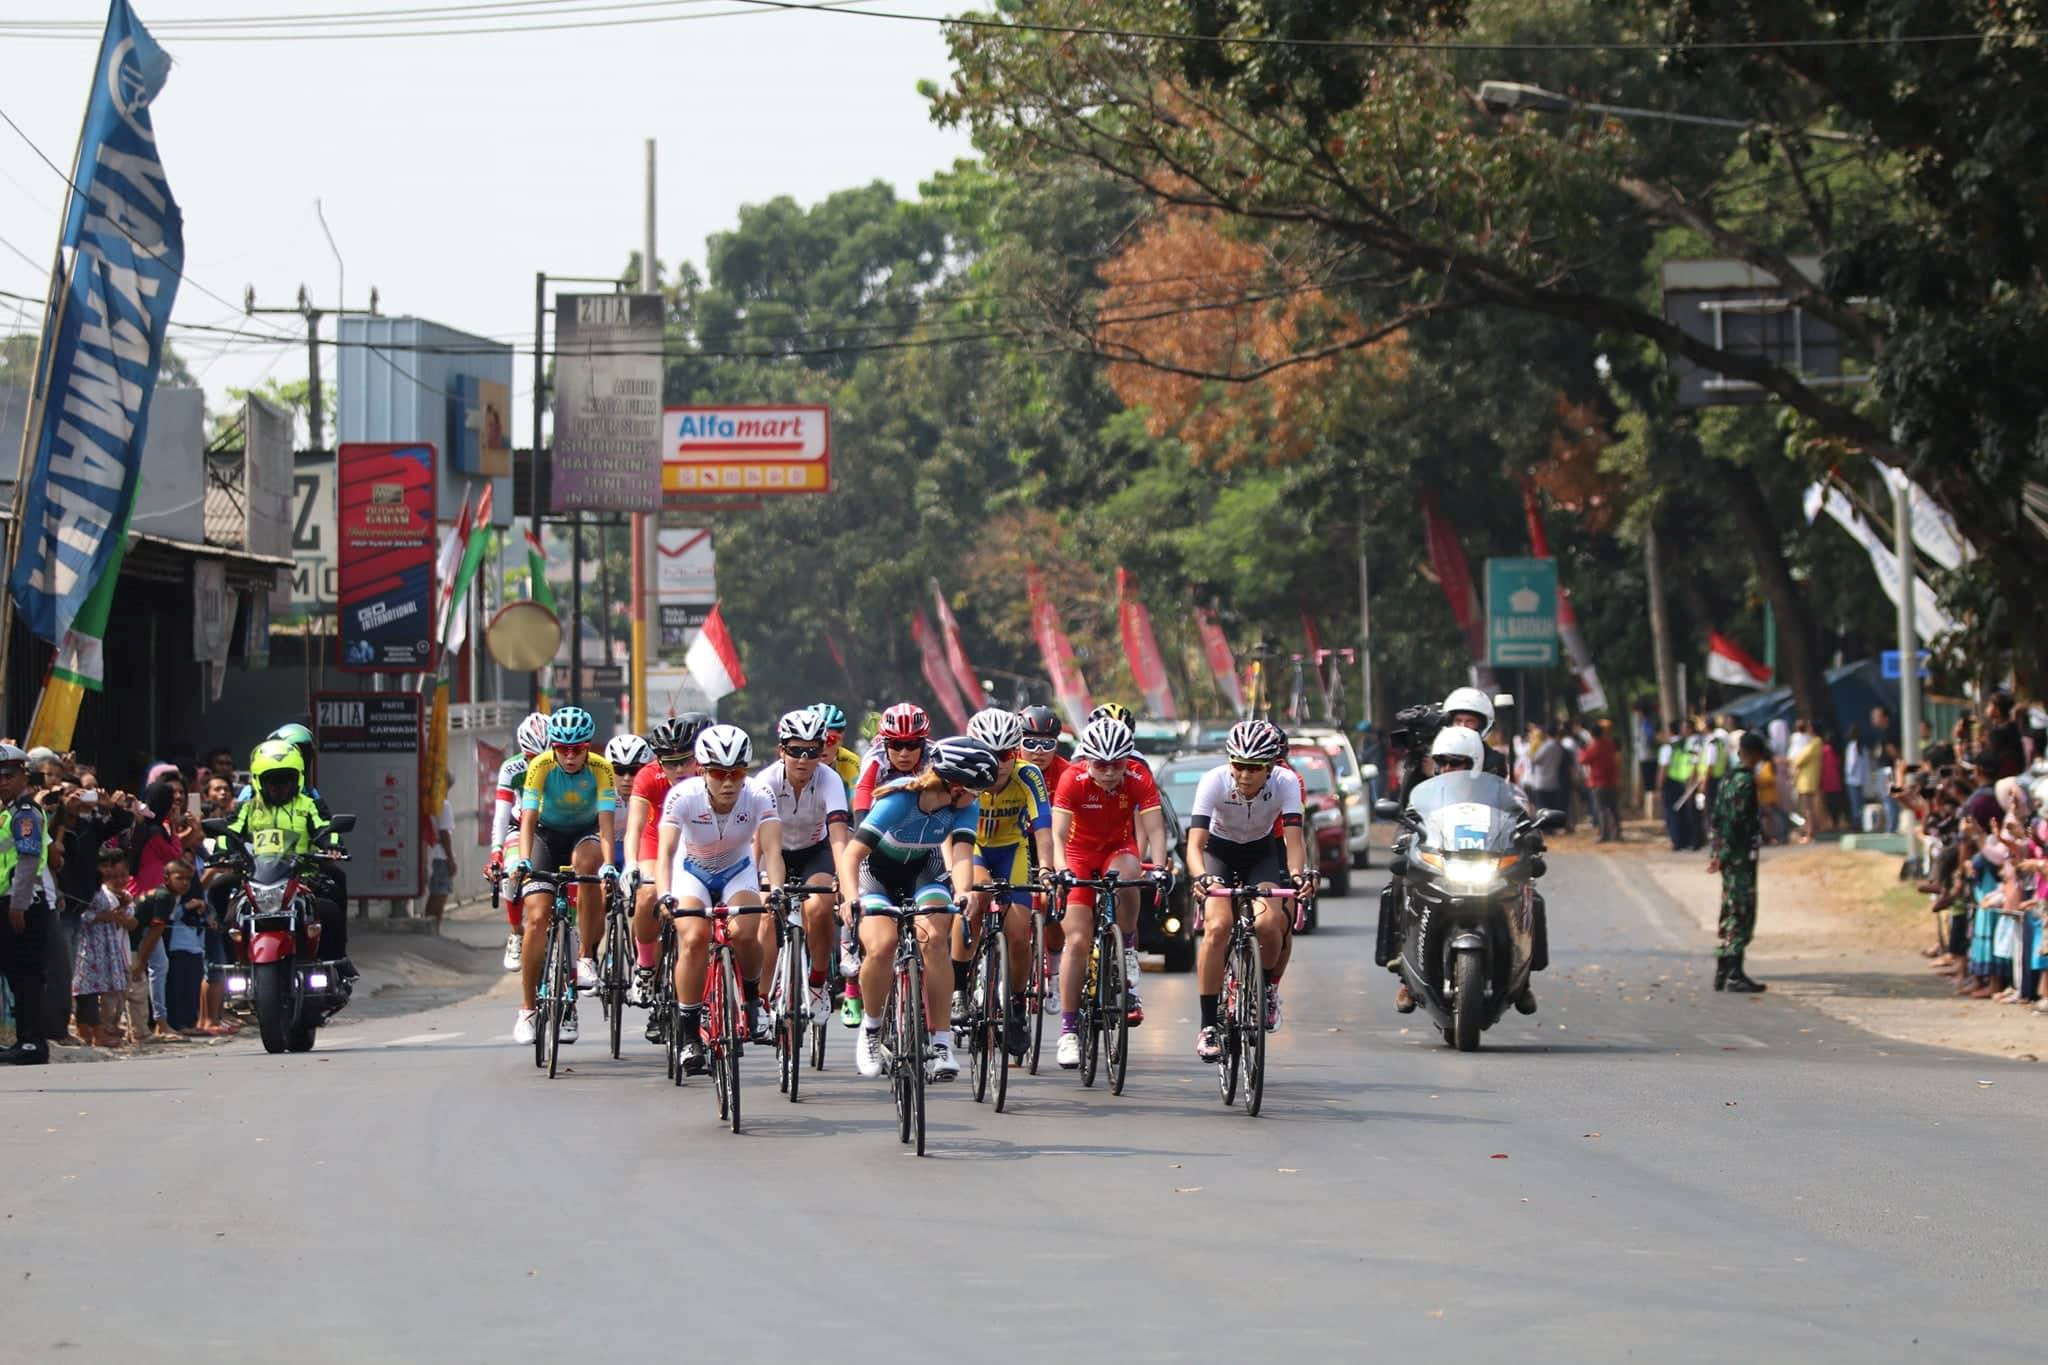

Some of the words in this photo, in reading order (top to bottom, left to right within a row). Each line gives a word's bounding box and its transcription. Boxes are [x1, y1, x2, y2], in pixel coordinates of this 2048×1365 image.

[580, 298, 628, 322] ZIA
[678, 415, 804, 438] Alfamart
[365, 515, 410, 524] GARAM
[361, 600, 418, 632] INTERNATIONAL
[320, 703, 362, 726] ZIA
[369, 726, 418, 734] CARWASH
[257, 832, 280, 847] 24
